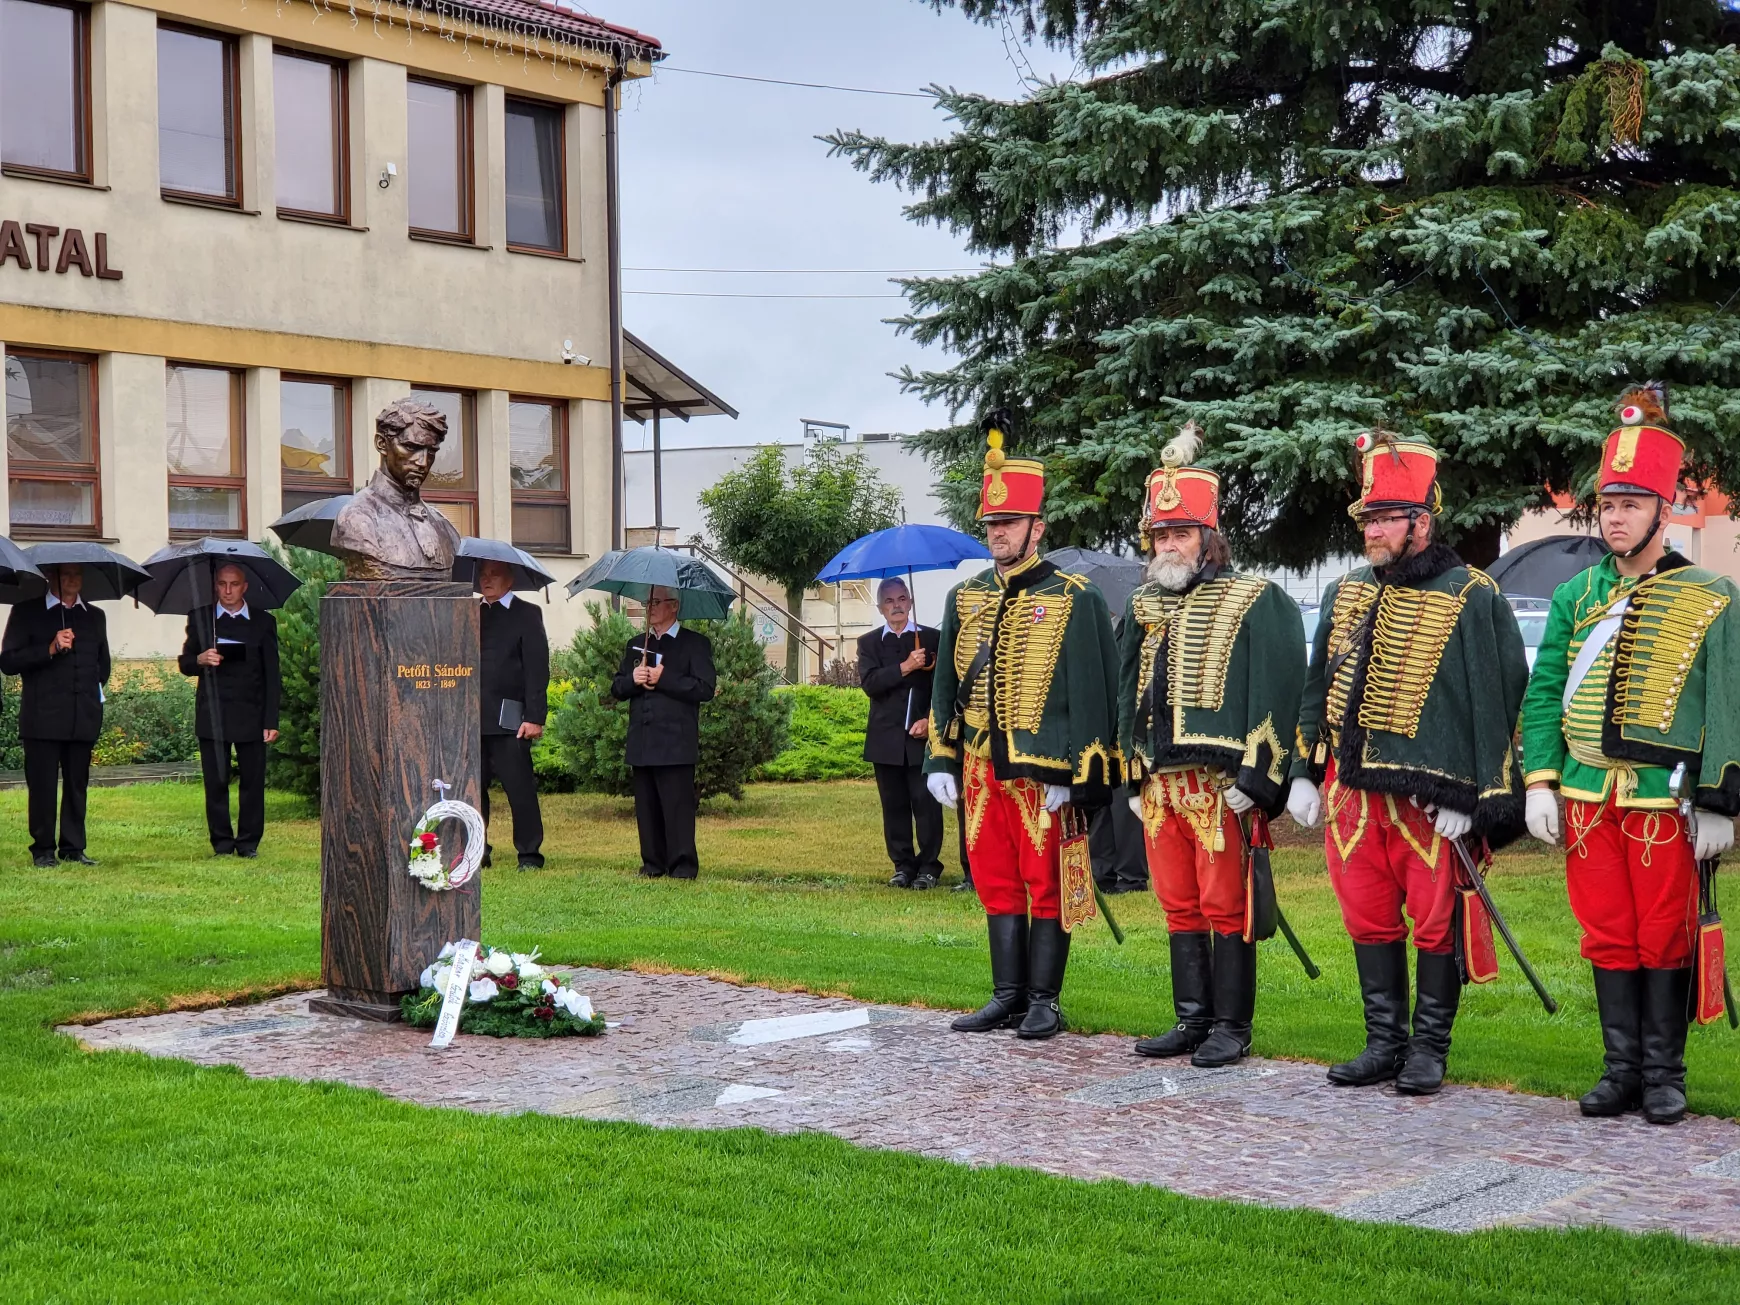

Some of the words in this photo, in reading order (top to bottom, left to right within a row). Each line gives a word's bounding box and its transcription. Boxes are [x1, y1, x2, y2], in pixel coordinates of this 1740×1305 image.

[0, 220, 123, 280] ATAL
[397, 664, 430, 678] Petőfi
[434, 663, 473, 677] Sándor
[415, 680, 431, 689] 1823
[440, 679, 456, 689] 1849
